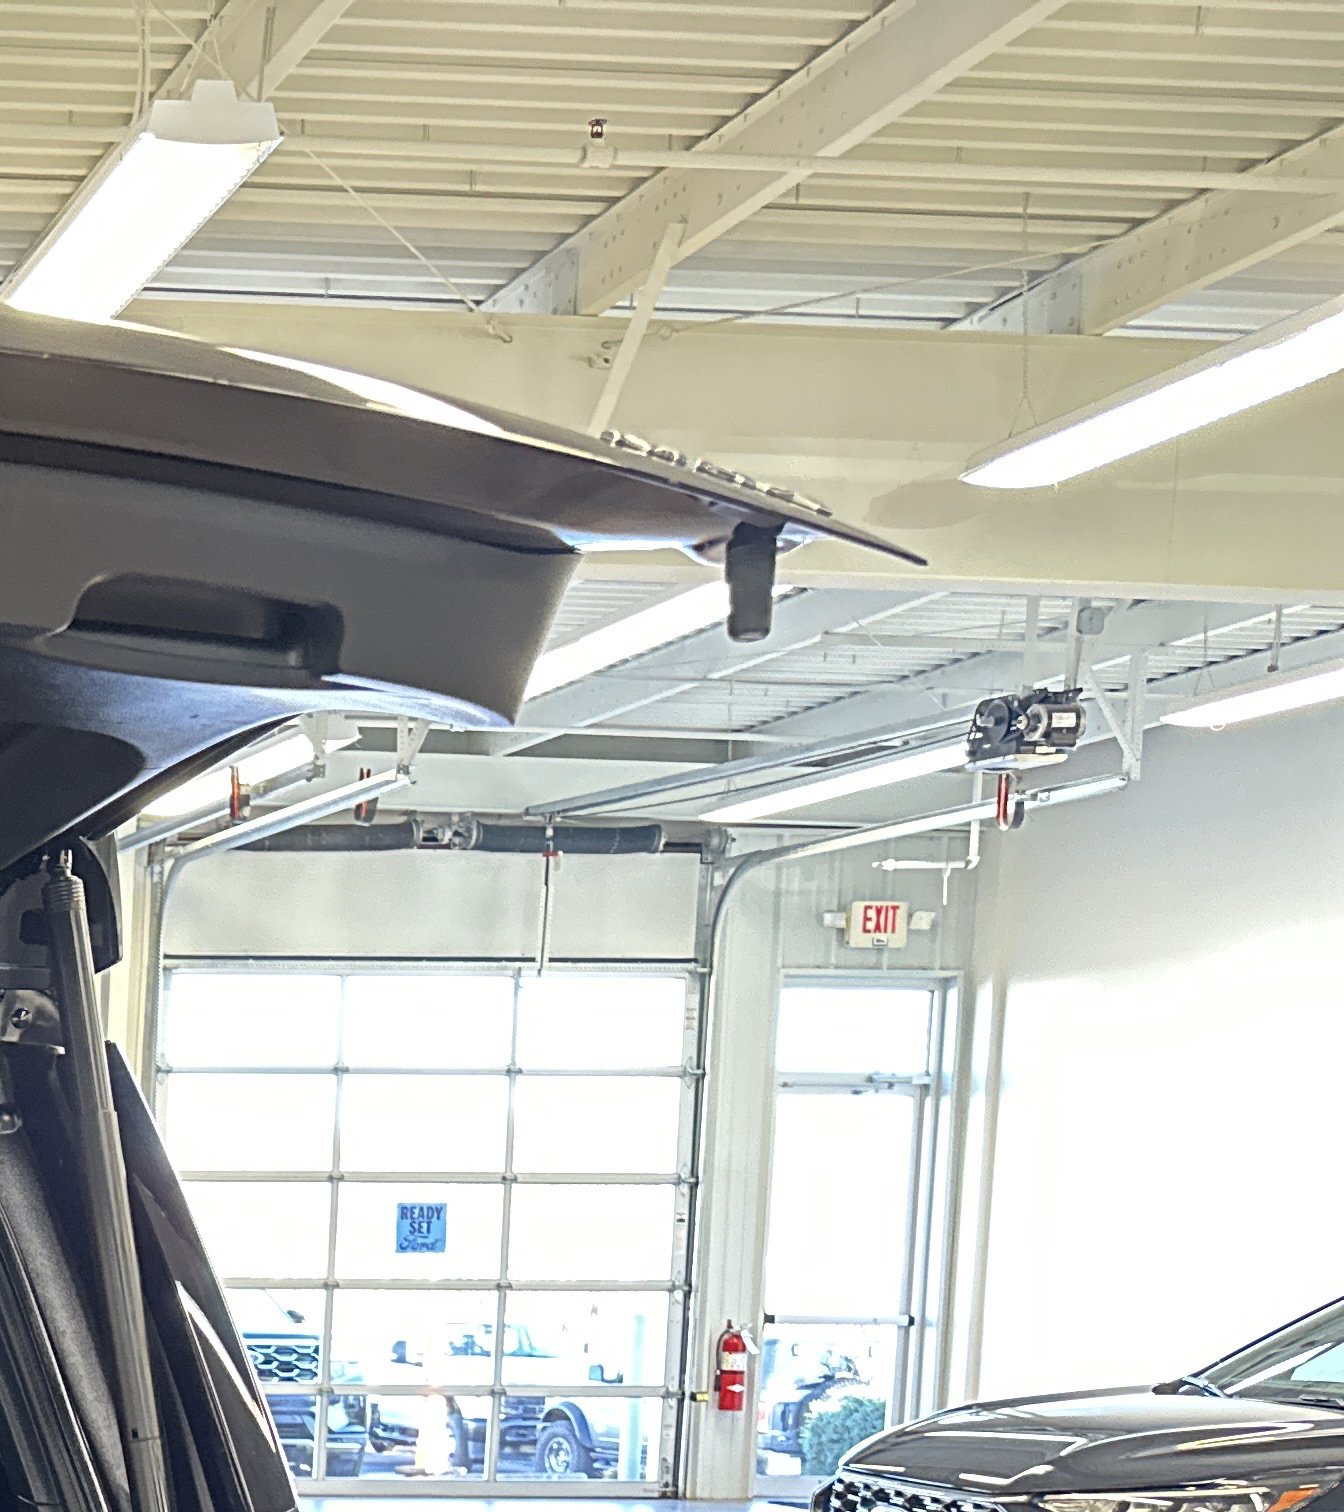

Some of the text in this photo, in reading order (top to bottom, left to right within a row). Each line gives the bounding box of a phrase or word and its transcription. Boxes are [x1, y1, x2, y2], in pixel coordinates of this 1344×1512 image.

[862, 905, 900, 934] EXIT
[400, 1206, 444, 1220] READY
[408, 1220, 433, 1235] SET
[399, 1235, 439, 1251] Ford
